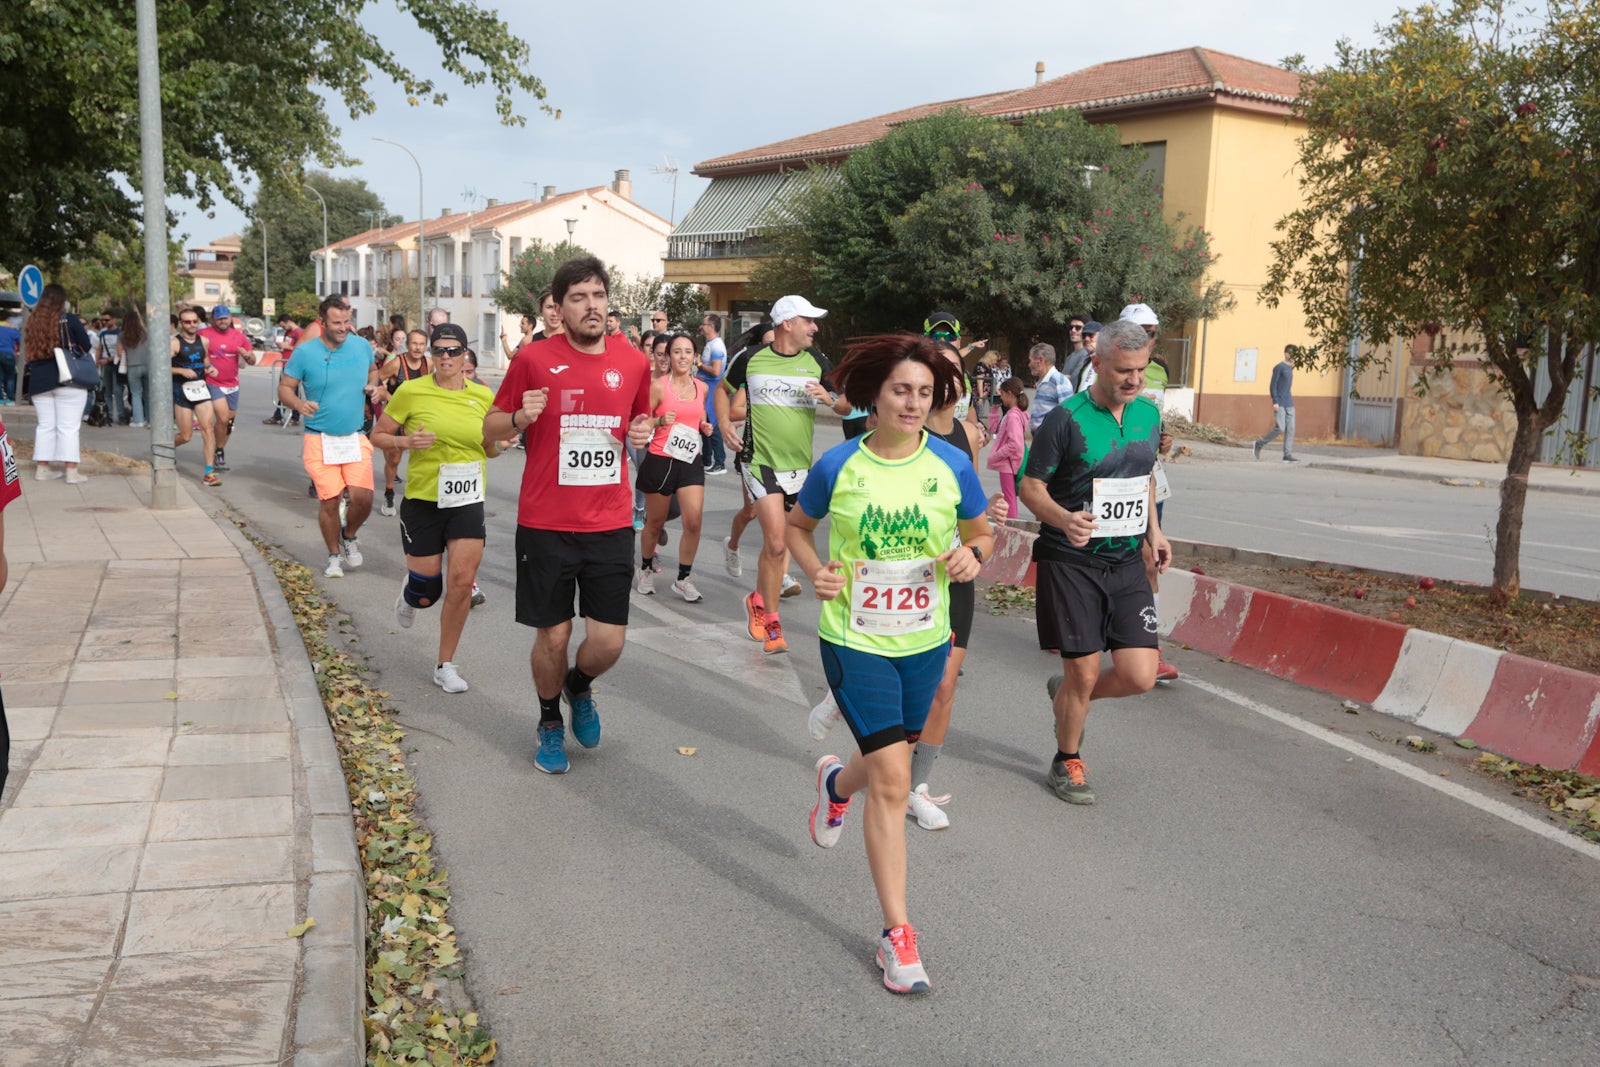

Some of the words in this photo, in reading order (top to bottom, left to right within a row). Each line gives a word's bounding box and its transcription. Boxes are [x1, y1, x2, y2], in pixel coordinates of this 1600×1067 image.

[560, 414, 622, 429] CARRERA
[671, 435, 697, 453] 3042
[567, 450, 615, 469] 3059
[444, 478, 477, 495] 3001
[1100, 499, 1143, 520] 3075
[879, 535, 927, 549] XXIV
[913, 545, 924, 554] 19
[879, 546, 911, 556] CIRCUITO
[861, 585, 930, 611] 2126
